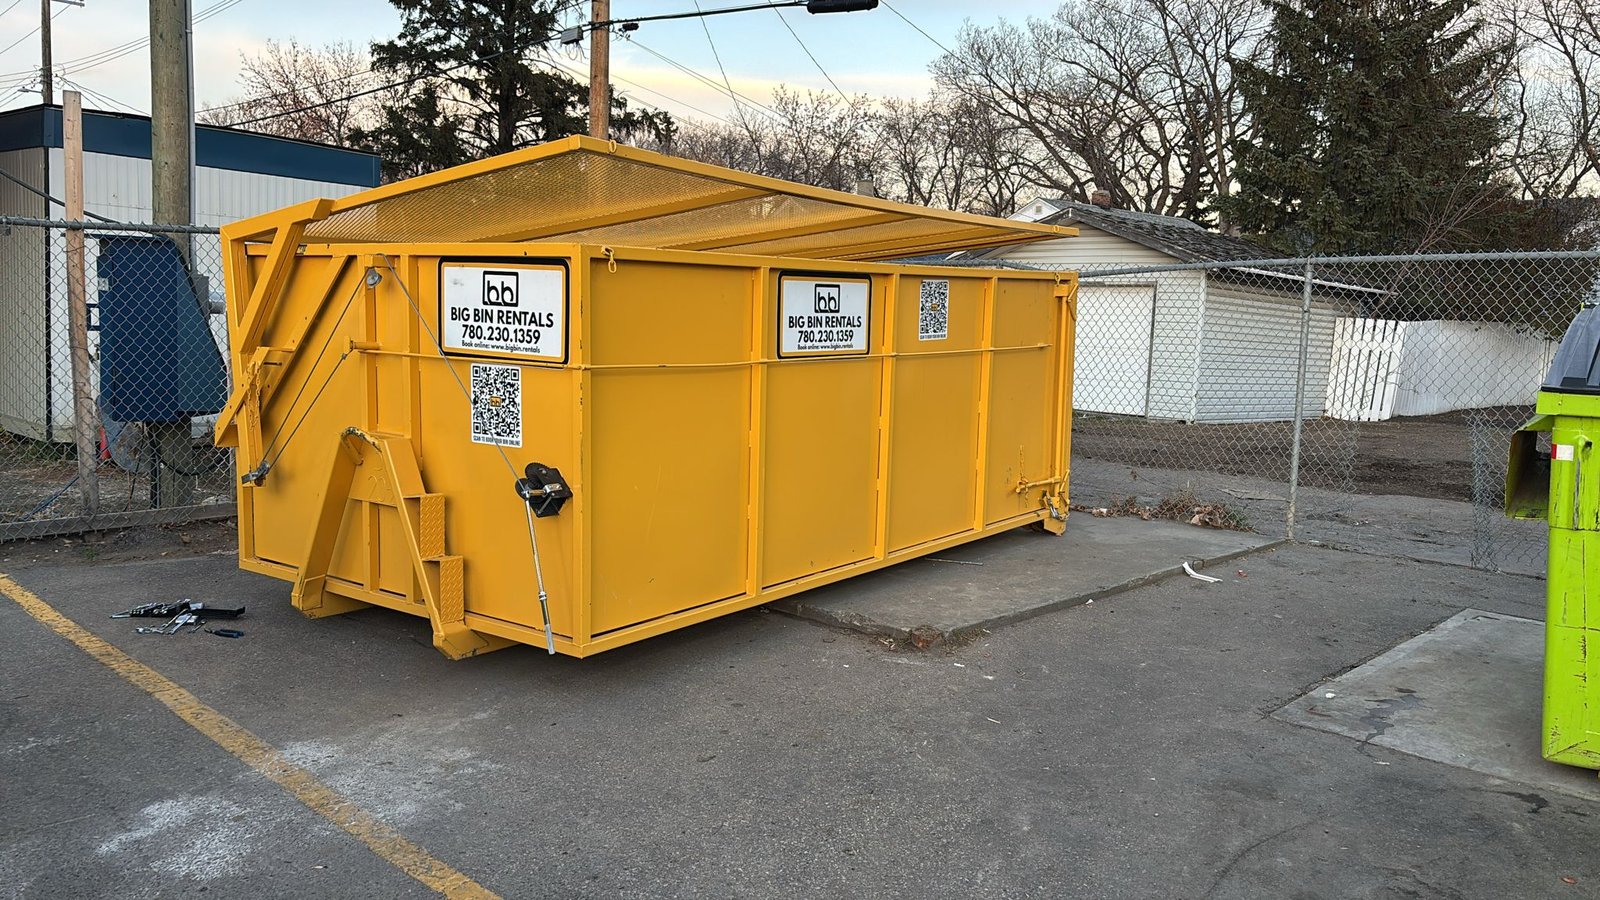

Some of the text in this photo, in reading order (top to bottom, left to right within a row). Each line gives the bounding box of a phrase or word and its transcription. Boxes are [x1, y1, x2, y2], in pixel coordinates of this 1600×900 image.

[451, 307, 554, 328] BIG BIN RENTALS
[788, 316, 862, 328] BIG BIN RENTALS
[462, 324, 540, 344] 780.230.1359
[798, 330, 854, 343] 780.230.1359
[462, 340, 541, 353] Book online: www.bigbin.rentals
